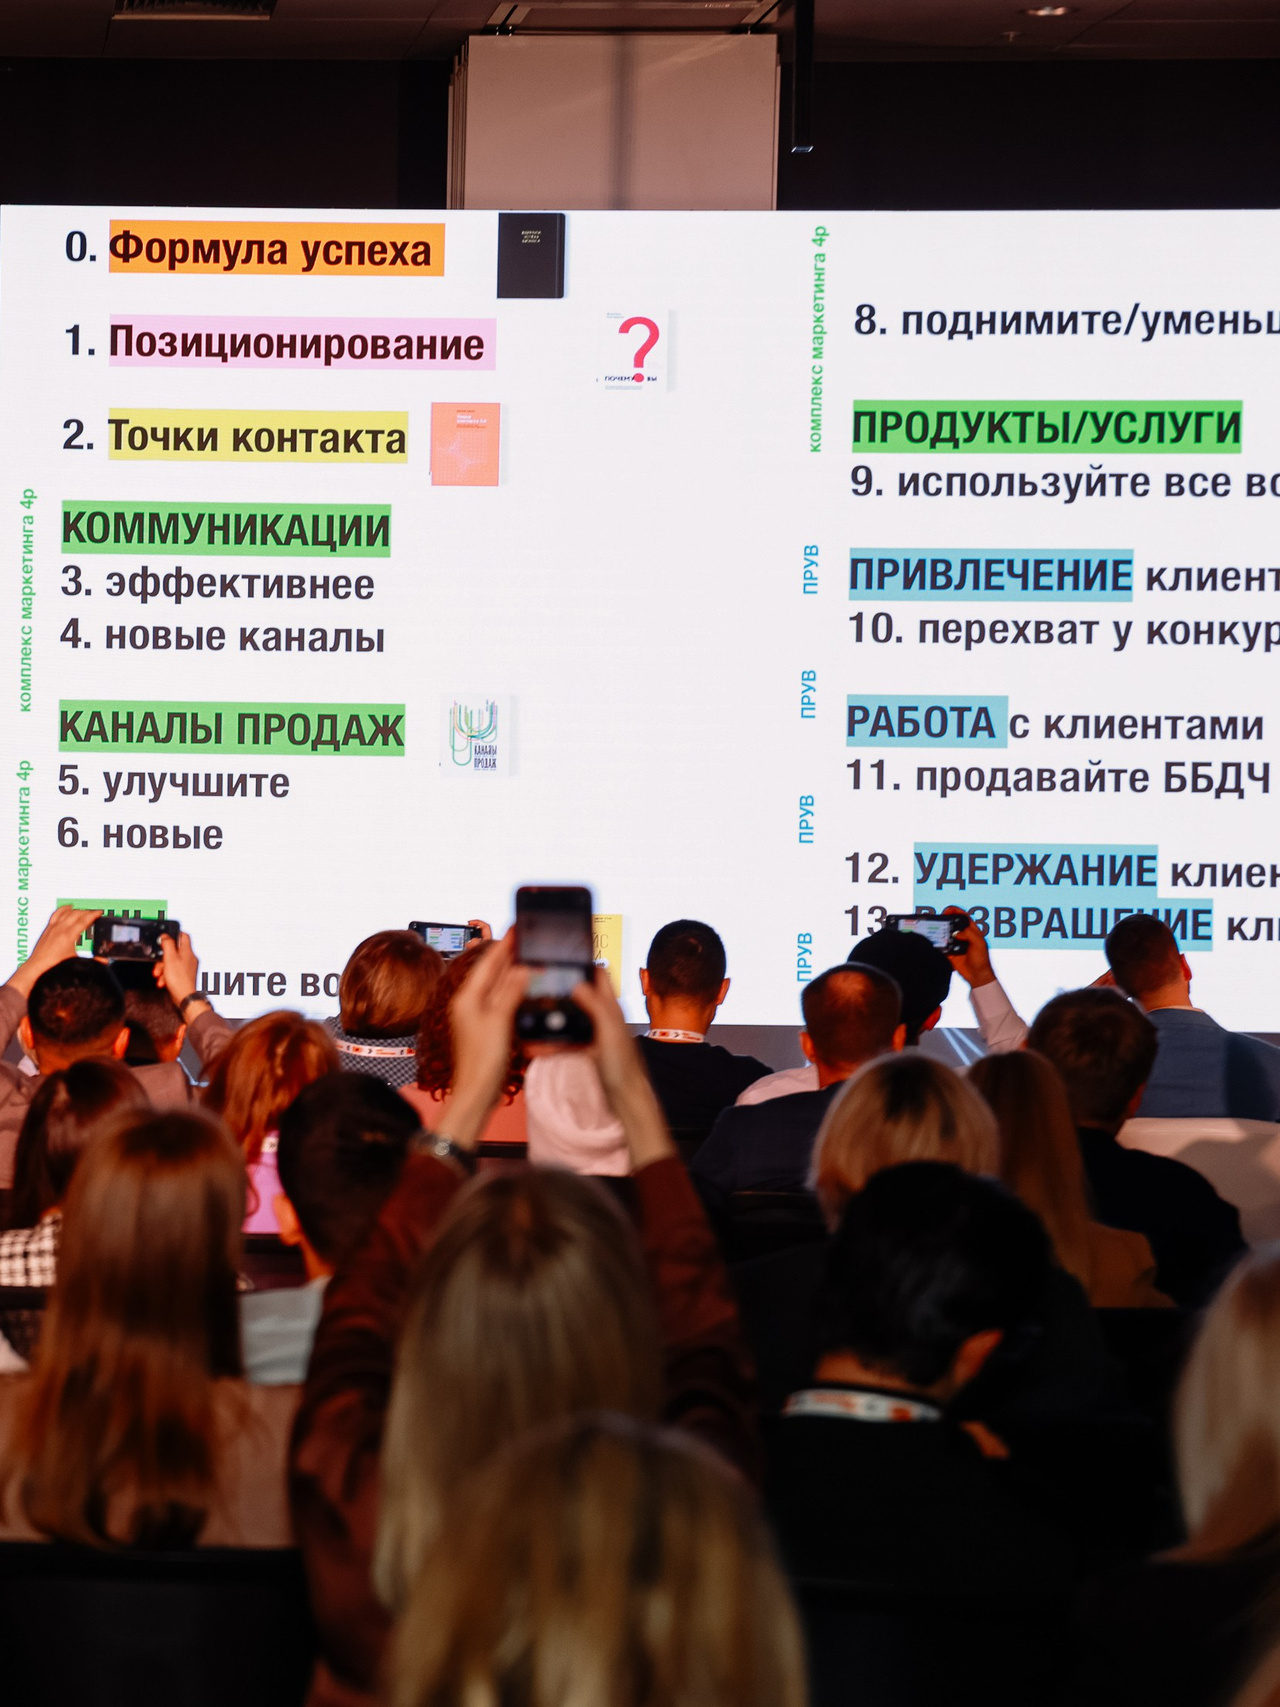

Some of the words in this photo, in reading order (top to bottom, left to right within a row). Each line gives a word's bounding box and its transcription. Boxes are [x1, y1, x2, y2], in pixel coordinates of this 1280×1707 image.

[65, 230, 97, 262] 0.
[109, 230, 287, 271] Формула
[301, 240, 431, 272] успеха
[812, 252, 827, 360] маркетинга
[855, 304, 886, 335] 8.
[65, 324, 95, 356] 1.
[110, 324, 484, 366] Позиционирование
[810, 364, 824, 452] комплекс
[63, 418, 94, 450] 2.
[107, 418, 218, 452] Точки
[232, 427, 406, 454] контакта
[853, 410, 1241, 449] ПРОДУКТЫ/УСЛУГИ
[851, 465, 883, 496] 9.
[899, 464, 1150, 504] используйте
[1165, 473, 1231, 497] все
[63, 511, 390, 553] КОММУНИКАЦИИ
[21, 515, 37, 619] маркетинга
[61, 565, 92, 596] 3.
[106, 565, 374, 605] эффективнее
[802, 544, 819, 594] ПРУВ
[850, 558, 1132, 591] ПРИВЛЕЧЕНИЕ
[60, 617, 91, 649] 4.
[106, 625, 226, 651] новые
[240, 627, 384, 653] каналы
[849, 612, 902, 643] 10.
[919, 619, 1100, 651] перехват
[1113, 621, 1133, 652] у
[20, 625, 33, 712] комплекс
[800, 669, 817, 719] ПРУВ
[60, 710, 223, 745] КАНАЛЫ
[237, 713, 405, 752] ПРОДАЖ
[848, 705, 995, 738] РАБОТА
[1009, 714, 1030, 739] с
[1044, 715, 1263, 740] клиентами
[58, 764, 89, 795] 5.
[103, 771, 290, 803] улучшите
[846, 759, 900, 790] 11.
[917, 760, 1149, 798] продавайте
[1164, 761, 1270, 800] ББДЧ
[17, 786, 33, 891] маркетинга
[57, 816, 88, 848] 6.
[103, 824, 223, 850] новые
[798, 794, 815, 843] ПРУВ
[845, 852, 899, 884] 12.
[914, 852, 1157, 890] УДЕРЖАНИЕ
[17, 897, 29, 969] мплекс
[1228, 917, 1280, 941] кл
[796, 932, 813, 982] ПРУВ
